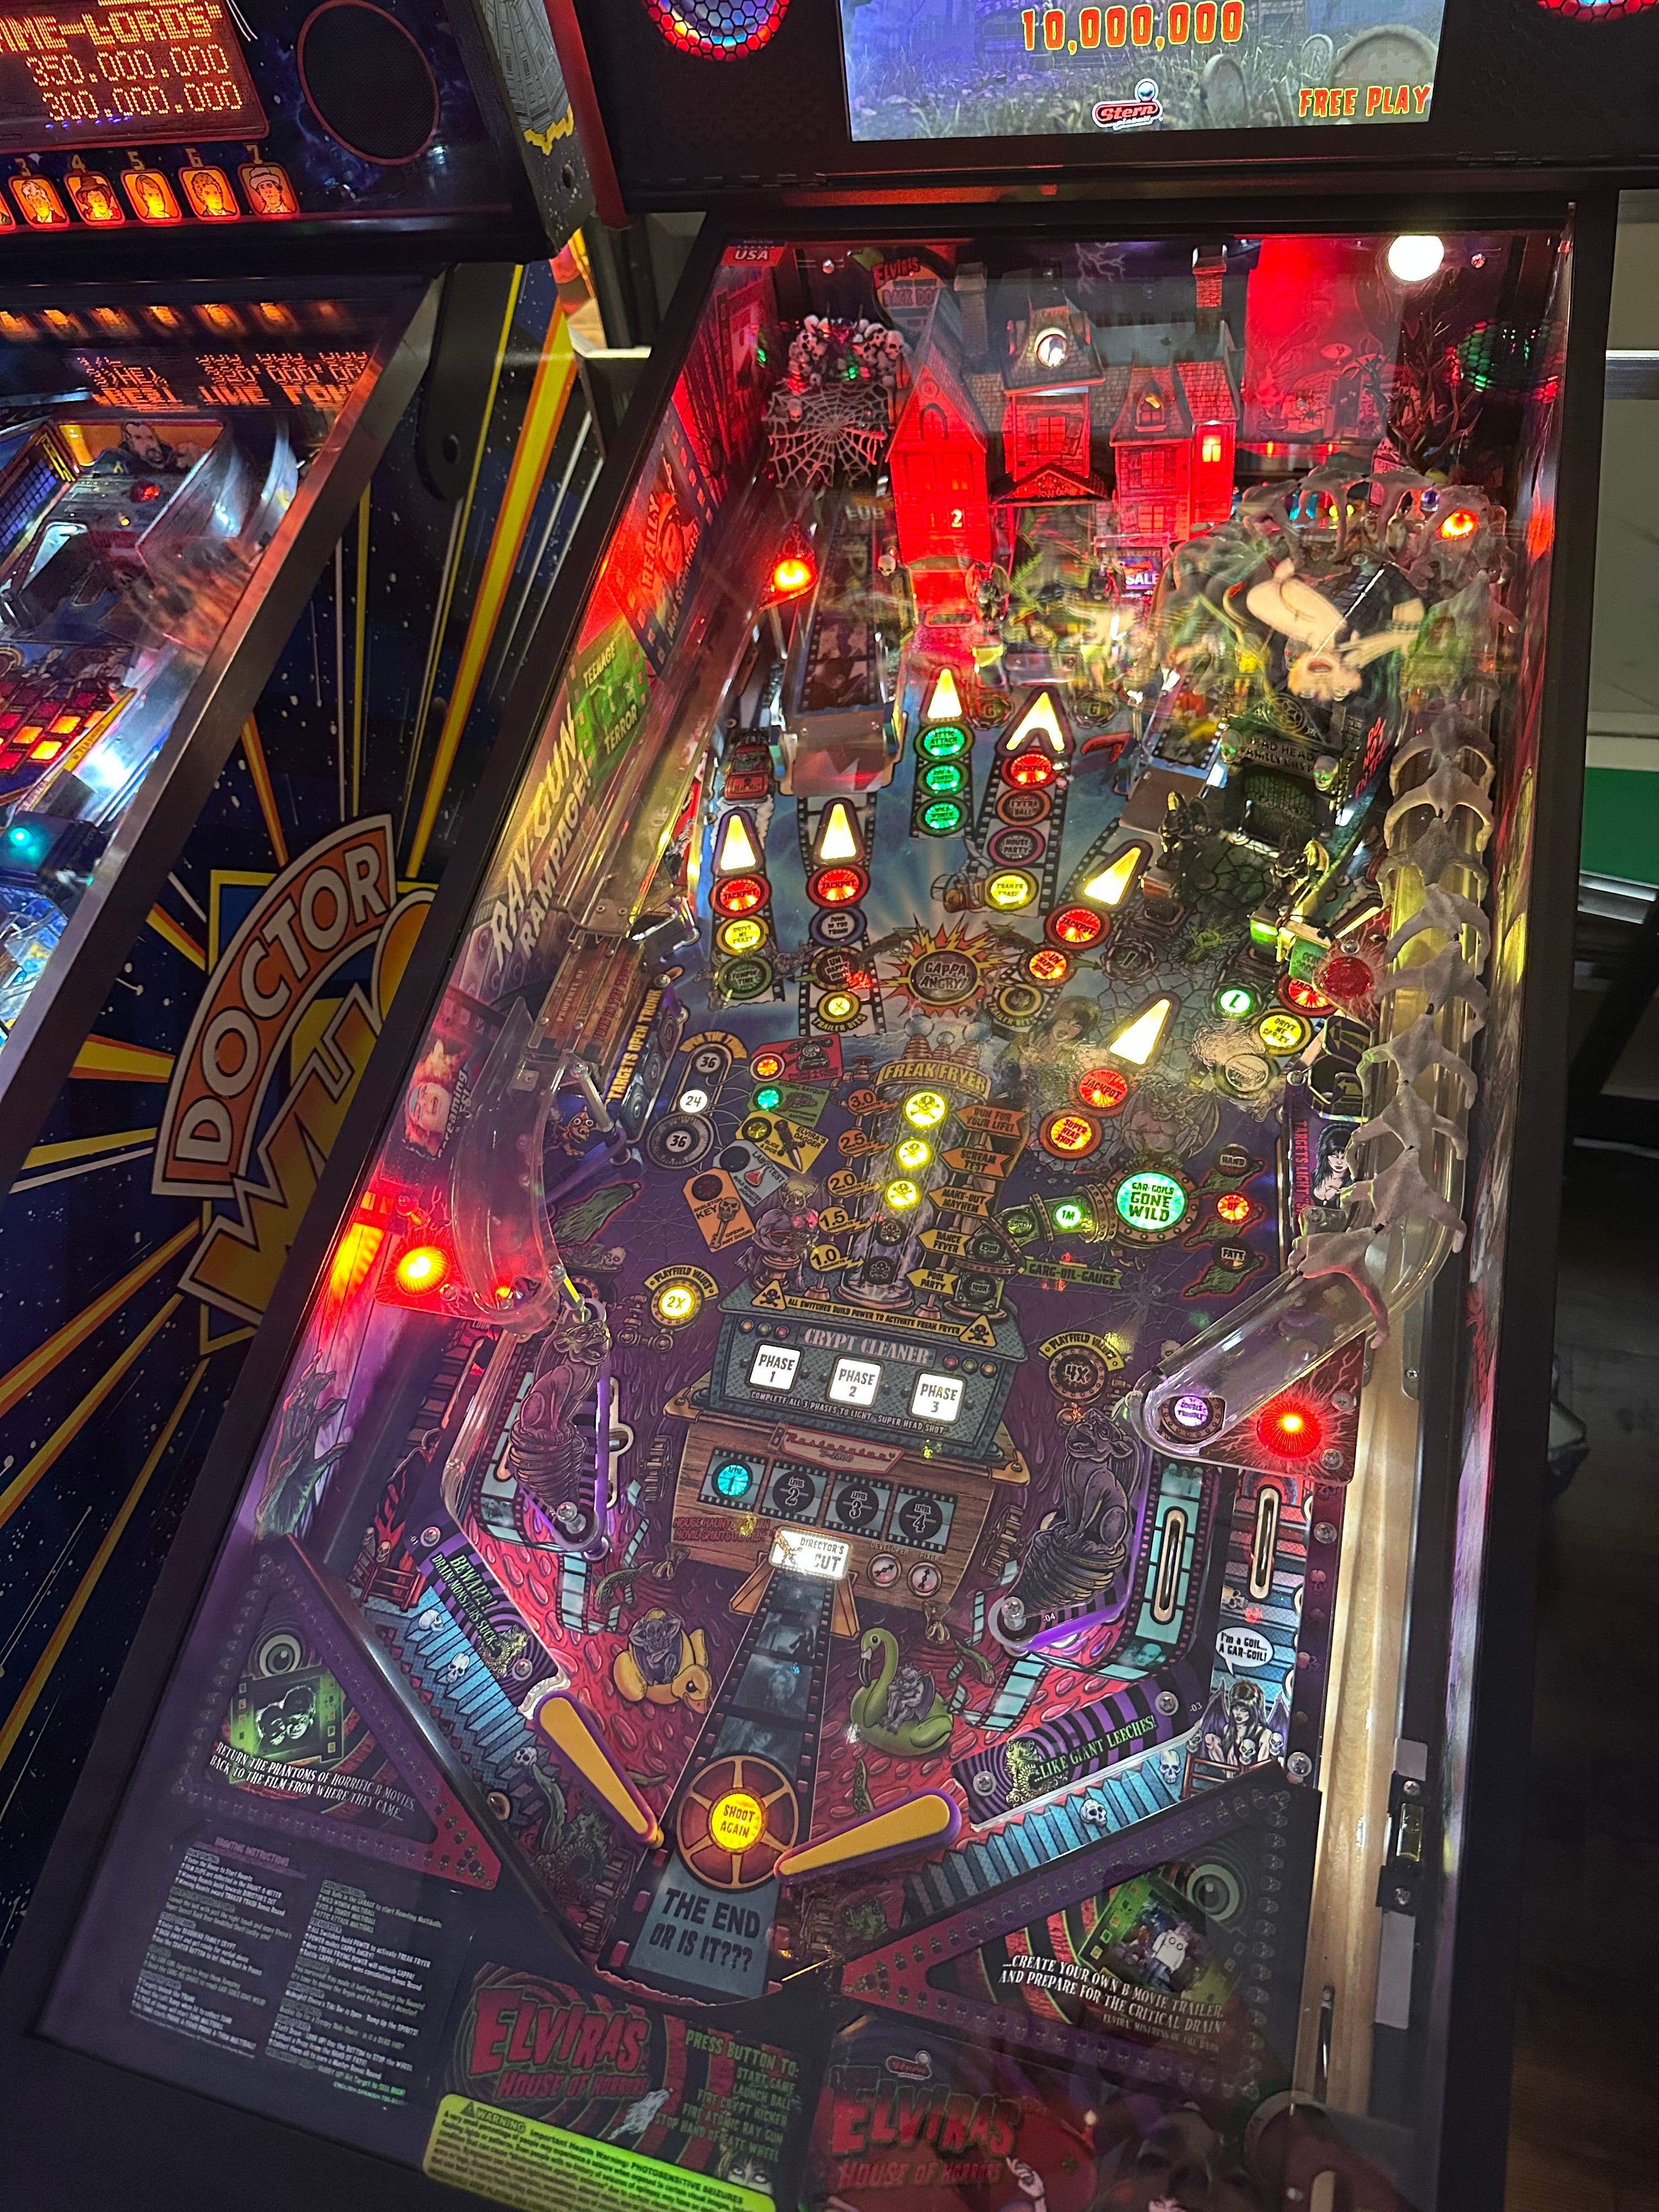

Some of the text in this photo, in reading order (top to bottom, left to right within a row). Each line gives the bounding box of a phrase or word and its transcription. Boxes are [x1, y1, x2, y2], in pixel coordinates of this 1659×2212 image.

[1021, 0, 1245, 55] 10,000,000
[26, 44, 230, 87] 350.000.000
[42, 81, 243, 121] 300.000.000
[1299, 84, 1431, 117] FREE PLAY
[1101, 102, 1156, 122] Stern
[72, 144, 264, 173] 4 5 6 7
[735, 250, 769, 261] USA
[641, 494, 661, 589] REALLY
[1126, 573, 1160, 585] SALE
[584, 640, 616, 682] TEENAGE
[605, 703, 637, 755] TERROR
[518, 756, 589, 959] RAMPAGE!
[823, 880, 856, 889] JACKPOT
[723, 888, 758, 900] JACKPOT
[1061, 917, 1096, 934] JACKPOT
[924, 962, 966, 976] GAPPA
[920, 974, 970, 990] ANGRY!
[173, 843, 387, 1163] DOCTOR
[812, 1014, 866, 1031] TRAILER BITS
[1274, 1018, 1296, 1031] DRIVE
[1276, 1026, 1285, 1035] ME
[607, 989, 662, 1099] TARGETS OPEN TRUNK
[701, 1057, 716, 1068] 36
[884, 1064, 985, 1091] FREAK FRYER
[1085, 1079, 1123, 1099] JACKPOT
[686, 1096, 701, 1106] 24
[850, 1092, 873, 1108] 3.0
[967, 1116, 1014, 1132] YOUR LIFE!
[992, 1113, 1011, 1122] FOR
[796, 1127, 826, 1143] ELVIRA'S
[1062, 1127, 1080, 1140] HEAD
[1064, 1120, 1087, 1134] SUPER
[671, 1136, 688, 1147] 36
[793, 1133, 821, 1149] DAGGER
[841, 1132, 865, 1148] 2.5
[1056, 1135, 1075, 1147] SHOT
[1220, 1155, 1245, 1165] HAND
[1294, 1120, 1310, 1195] TARGETS LIGHT
[830, 1173, 855, 1189] 2.0
[942, 1189, 985, 1204] MAKE-OUT
[943, 1198, 979, 1212] MAYHEM
[1131, 1193, 1171, 1207] GONE
[696, 1206, 717, 1220] KEY
[821, 1210, 846, 1226] 1.5
[1062, 1210, 1075, 1221] 1M
[1129, 1206, 1170, 1222] WILD
[934, 1240, 958, 1252] FEVER
[936, 1232, 962, 1243] DANCE
[811, 1249, 837, 1265] 1.0
[1222, 1249, 1244, 1261] FATE
[654, 1267, 712, 1290] PLAYFIELD VALUES
[927, 1272, 944, 1280] POOL
[1029, 1265, 1116, 1285] GARG-OIL-GAUGE
[921, 1278, 945, 1290] PARTY
[667, 1296, 685, 1310] 2X
[800, 1301, 960, 1334] SWITCHES BUILD POWER ACTIVATE FREAK FRYER
[804, 1328, 927, 1364] CRYPT CLEANER
[1049, 1334, 1091, 1350] PLAYFIELD
[664, 791, 760, 1938] THE END
[759, 1355, 795, 1370] PHASE
[769, 1372, 775, 1383] 1
[838, 1368, 874, 1385] PHASE
[1065, 1365, 1091, 1385] 4X
[849, 1385, 856, 1397] 2
[920, 1383, 958, 1401] PHASE
[751, 1391, 922, 1431] COMPLETE ALL PHASES TO LIGHT HEAD
[932, 1401, 939, 1413] 3
[786, 1488, 800, 1505] 2
[849, 1499, 862, 1518] 3
[913, 1515, 927, 1533] 4
[800, 1536, 844, 1555] DIRECTOR'S
[814, 1553, 840, 1572] CUT
[432, 1554, 453, 1582] DRAIN
[448, 1577, 479, 1618] MONSTERS
[449, 1554, 498, 1611] BEWARE!
[1221, 1632, 1233, 1643] I'm
[1219, 1643, 1224, 1652] A
[1069, 1739, 1103, 1764] GIANT
[1106, 1715, 1155, 1746] LEECHES!
[216, 1742, 248, 1765] RETURN
[250, 1757, 267, 1771] THE
[267, 1762, 317, 1782] PHANTOMS
[318, 1771, 330, 1783] OF
[332, 1773, 374, 1792] HORRIFIC
[374, 1785, 383, 1796] B
[210, 1755, 231, 1775] BACK
[233, 1765, 245, 1779] TO
[246, 1771, 263, 1784] THE
[264, 1775, 287, 1791] FILM
[288, 1780, 314, 1796] FROM
[316, 1785, 347, 1802] WHERE
[351, 1792, 375, 1808] THEY
[723, 1805, 755, 1823] SHOOT
[720, 1822, 749, 1838] AGAIN
[649, 1923, 753, 1972] OR IS IT???
[1059, 1962, 1091, 1982] YOUR
[1092, 1972, 1118, 1995] OWN
[1121, 1983, 1131, 1996] B
[1132, 1987, 1167, 2010] MOVIE
[999, 1970, 1024, 1985] AND
[1026, 1973, 1077, 1995] PREPARE
[1080, 1984, 1101, 2004] FOR
[1103, 1993, 1125, 2013] THE
[1128, 2004, 1180, 2030] CRITICAL
[685, 2029, 799, 2078] PRESS BUTTON TO:
[496, 2072, 590, 2097] HOUSE OF
[736, 2067, 796, 2094] START GAME
[732, 2082, 769, 2103] LAUNCH
[477, 2107, 526, 2133] WARNING
